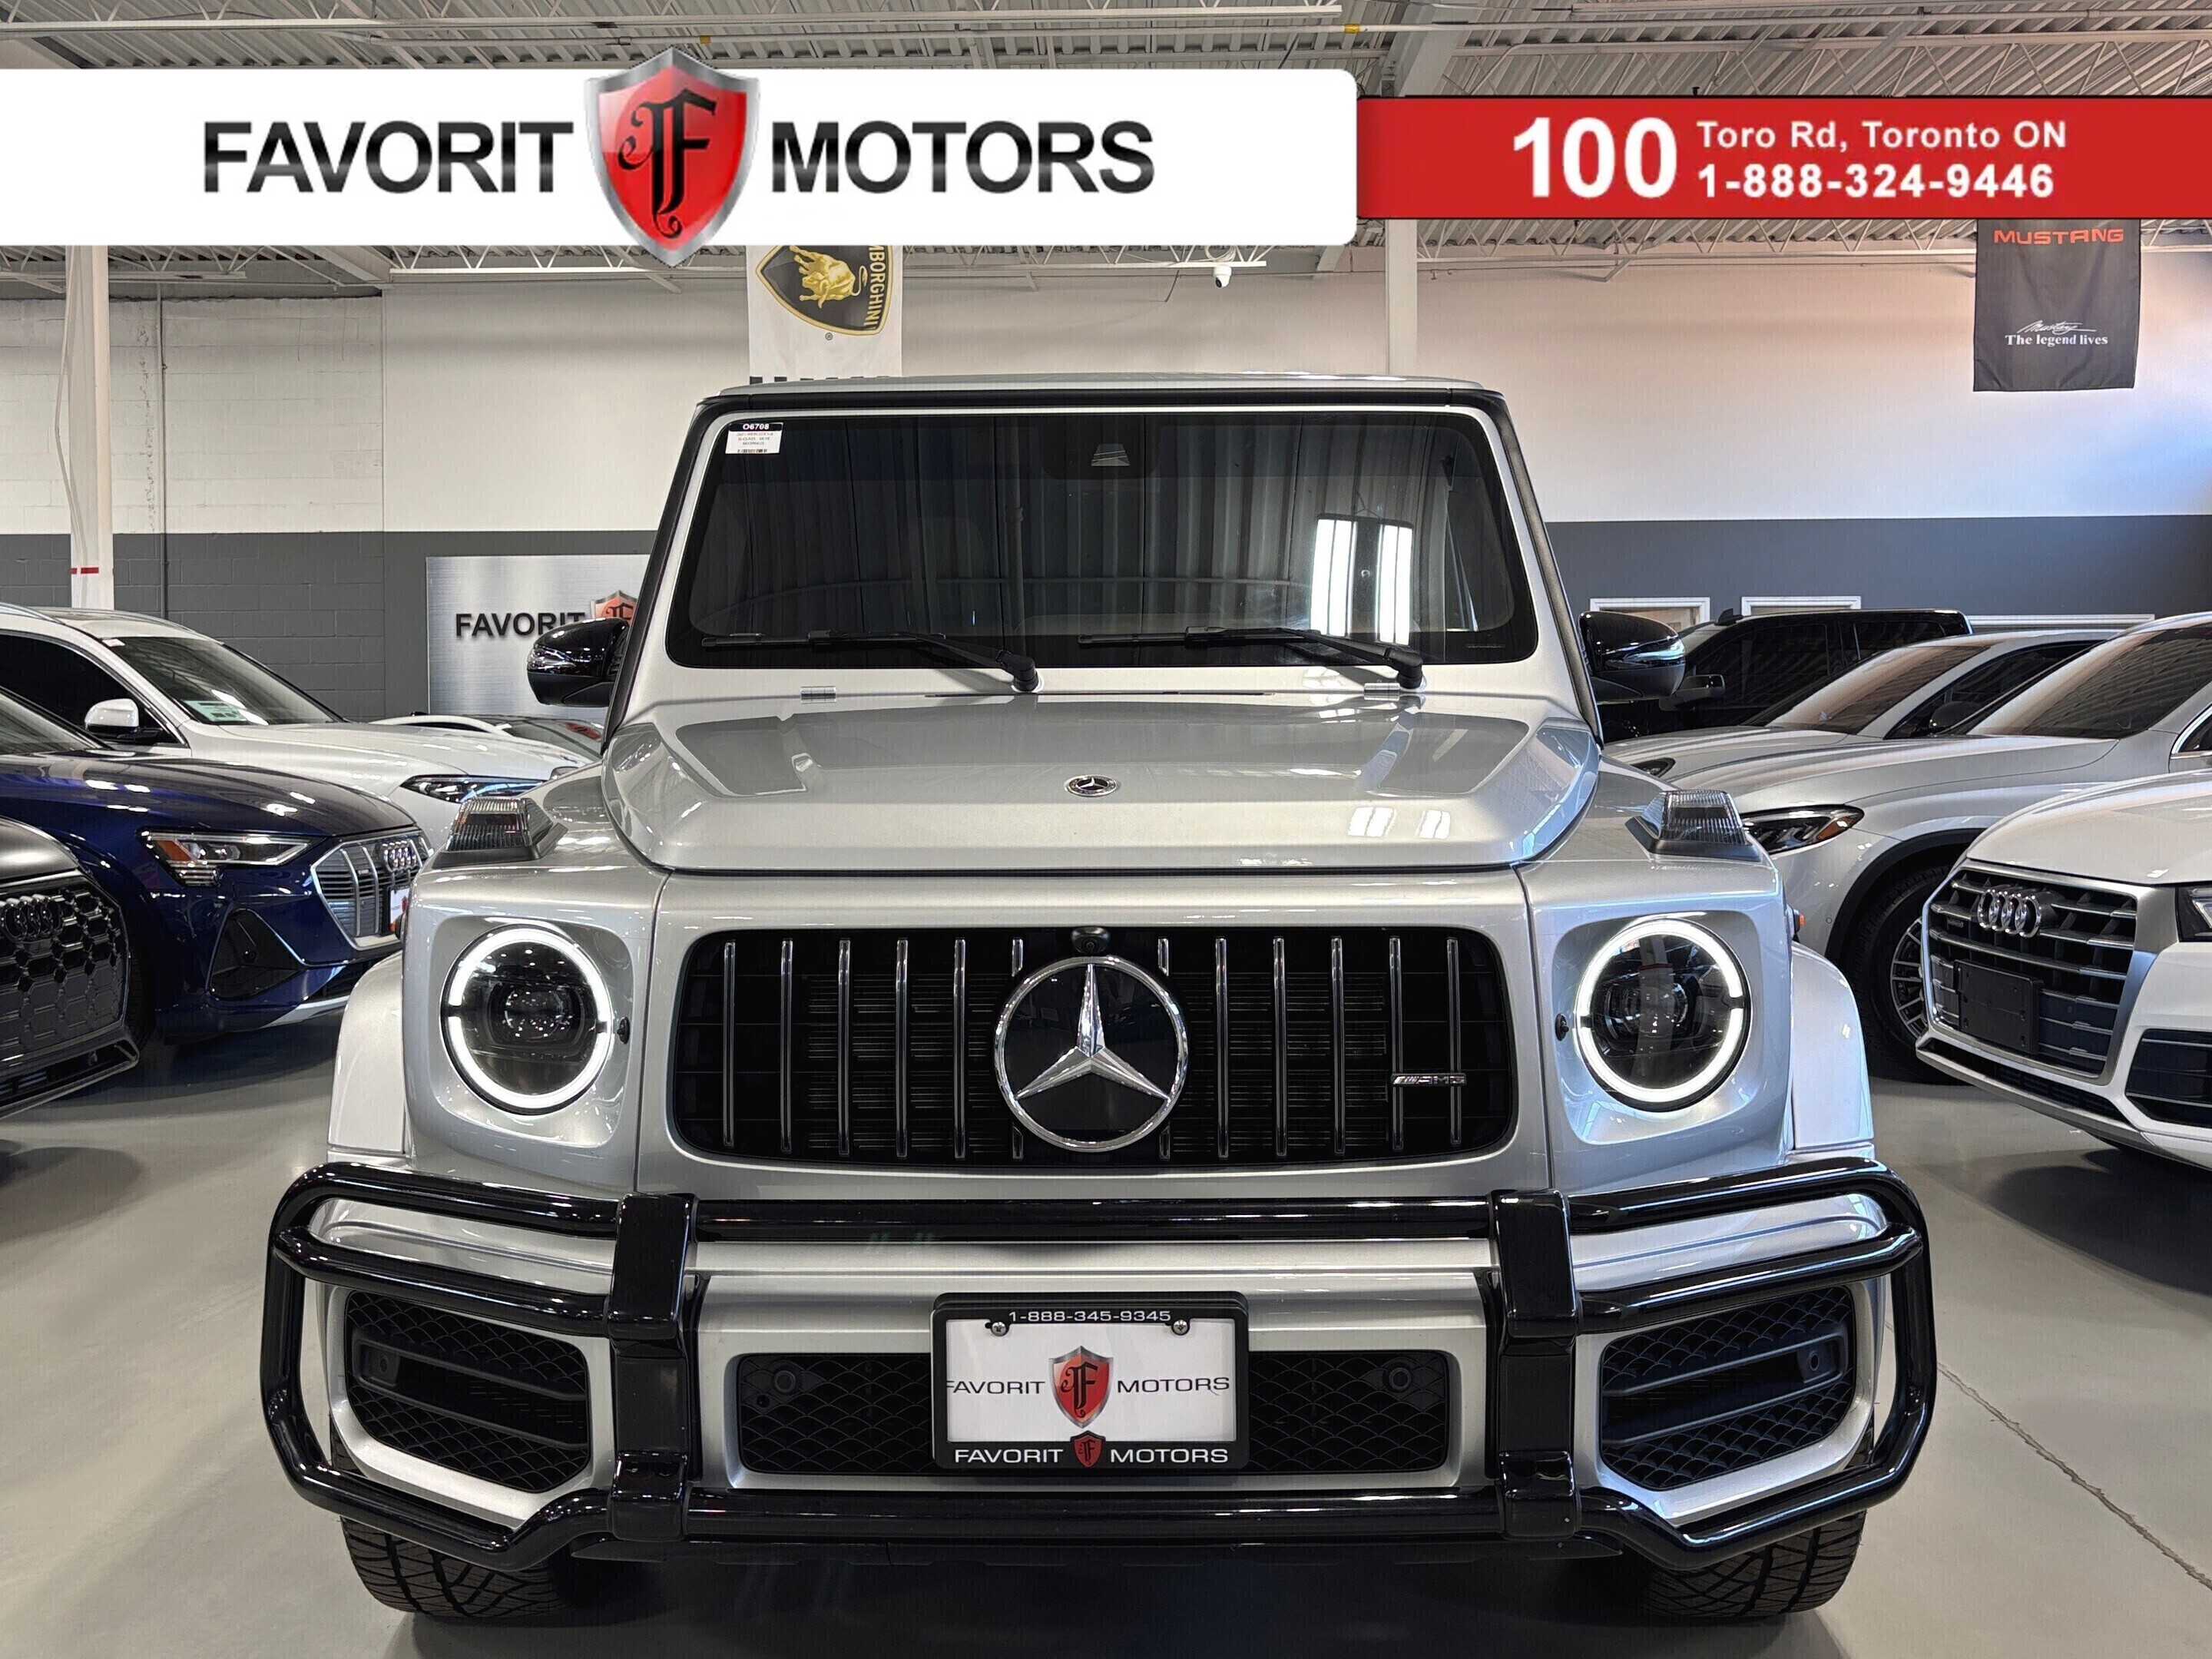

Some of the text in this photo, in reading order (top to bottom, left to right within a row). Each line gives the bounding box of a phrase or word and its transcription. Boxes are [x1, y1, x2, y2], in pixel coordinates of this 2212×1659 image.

[1993, 227, 2125, 245] MUSTANG
[2005, 334, 2109, 348] The legend lives
[1008, 1310, 1172, 1323] 1-888-345-9345
[1118, 1376, 1230, 1394] MOTORS
[955, 1449, 1064, 1463] FAVORIT
[1111, 1449, 1229, 1463] MOTORS
